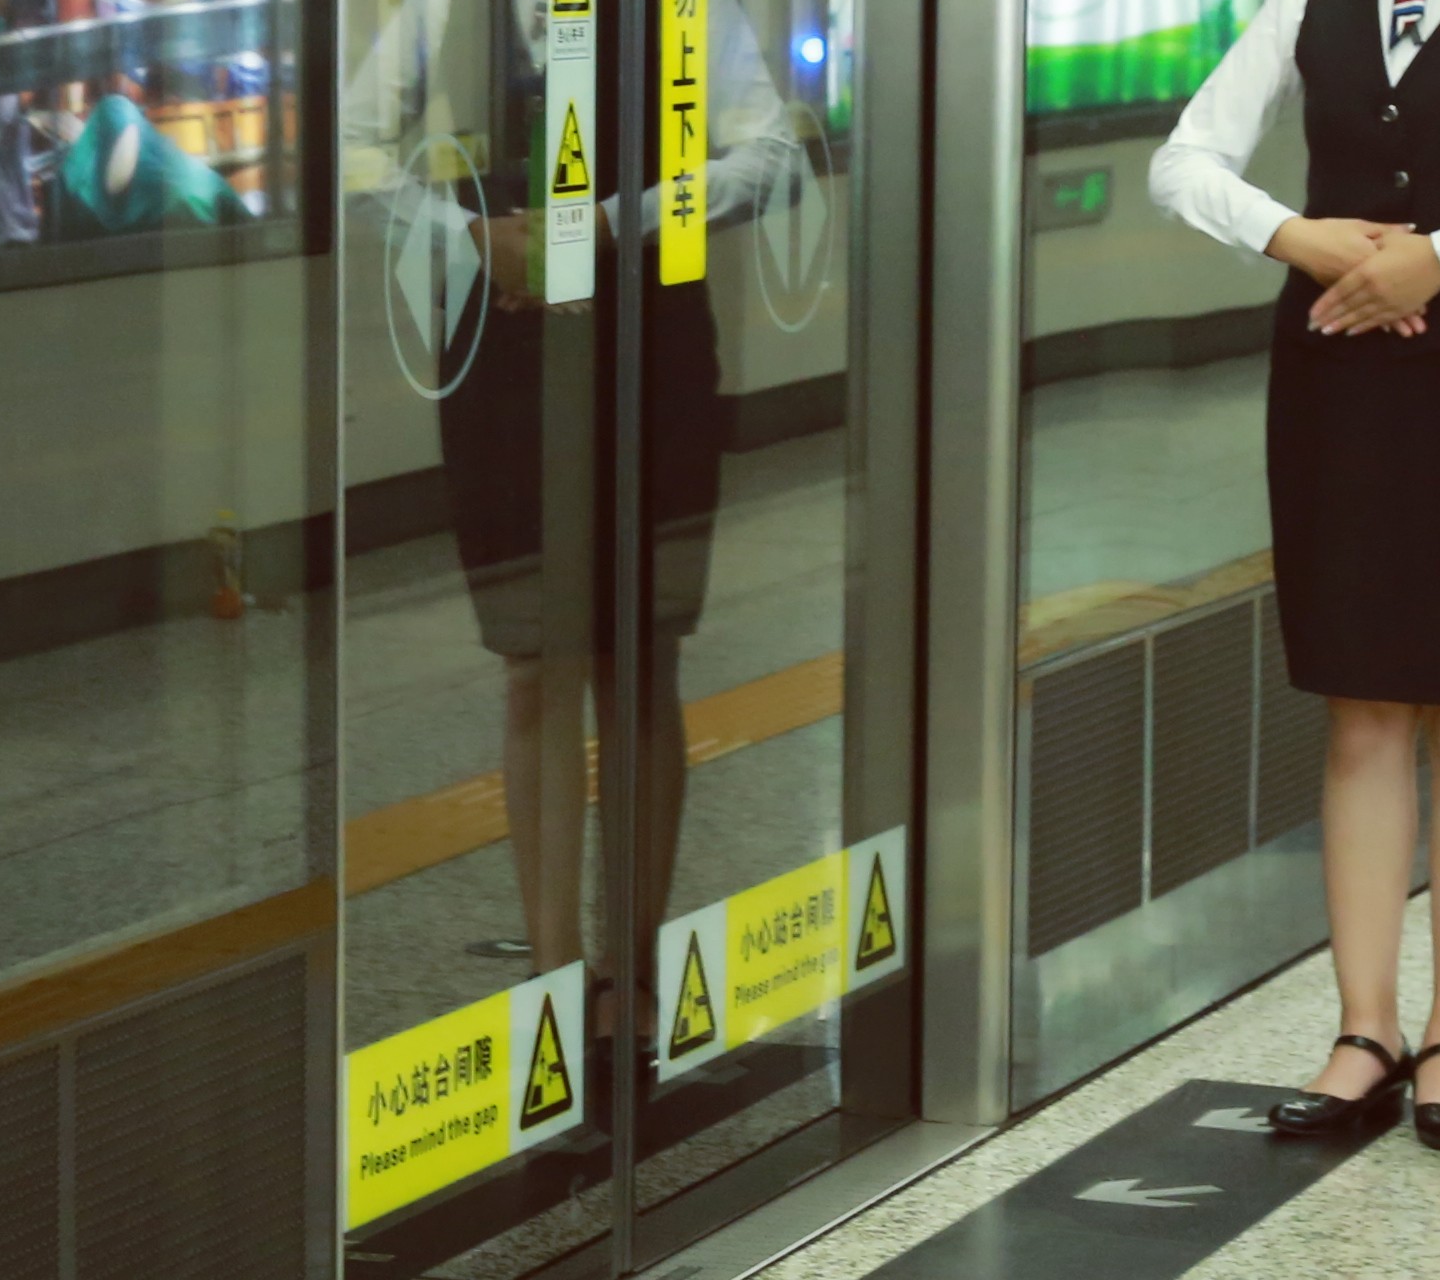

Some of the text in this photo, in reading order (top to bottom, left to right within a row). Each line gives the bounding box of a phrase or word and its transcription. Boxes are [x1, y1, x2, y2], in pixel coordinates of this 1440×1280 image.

[740, 888, 835, 962] 小心站台间隙
[734, 979, 768, 1008] Please
[771, 959, 798, 990] mind
[368, 1035, 493, 1127] 小心站台间隙
[360, 1105, 498, 1180] Please mind the gap
